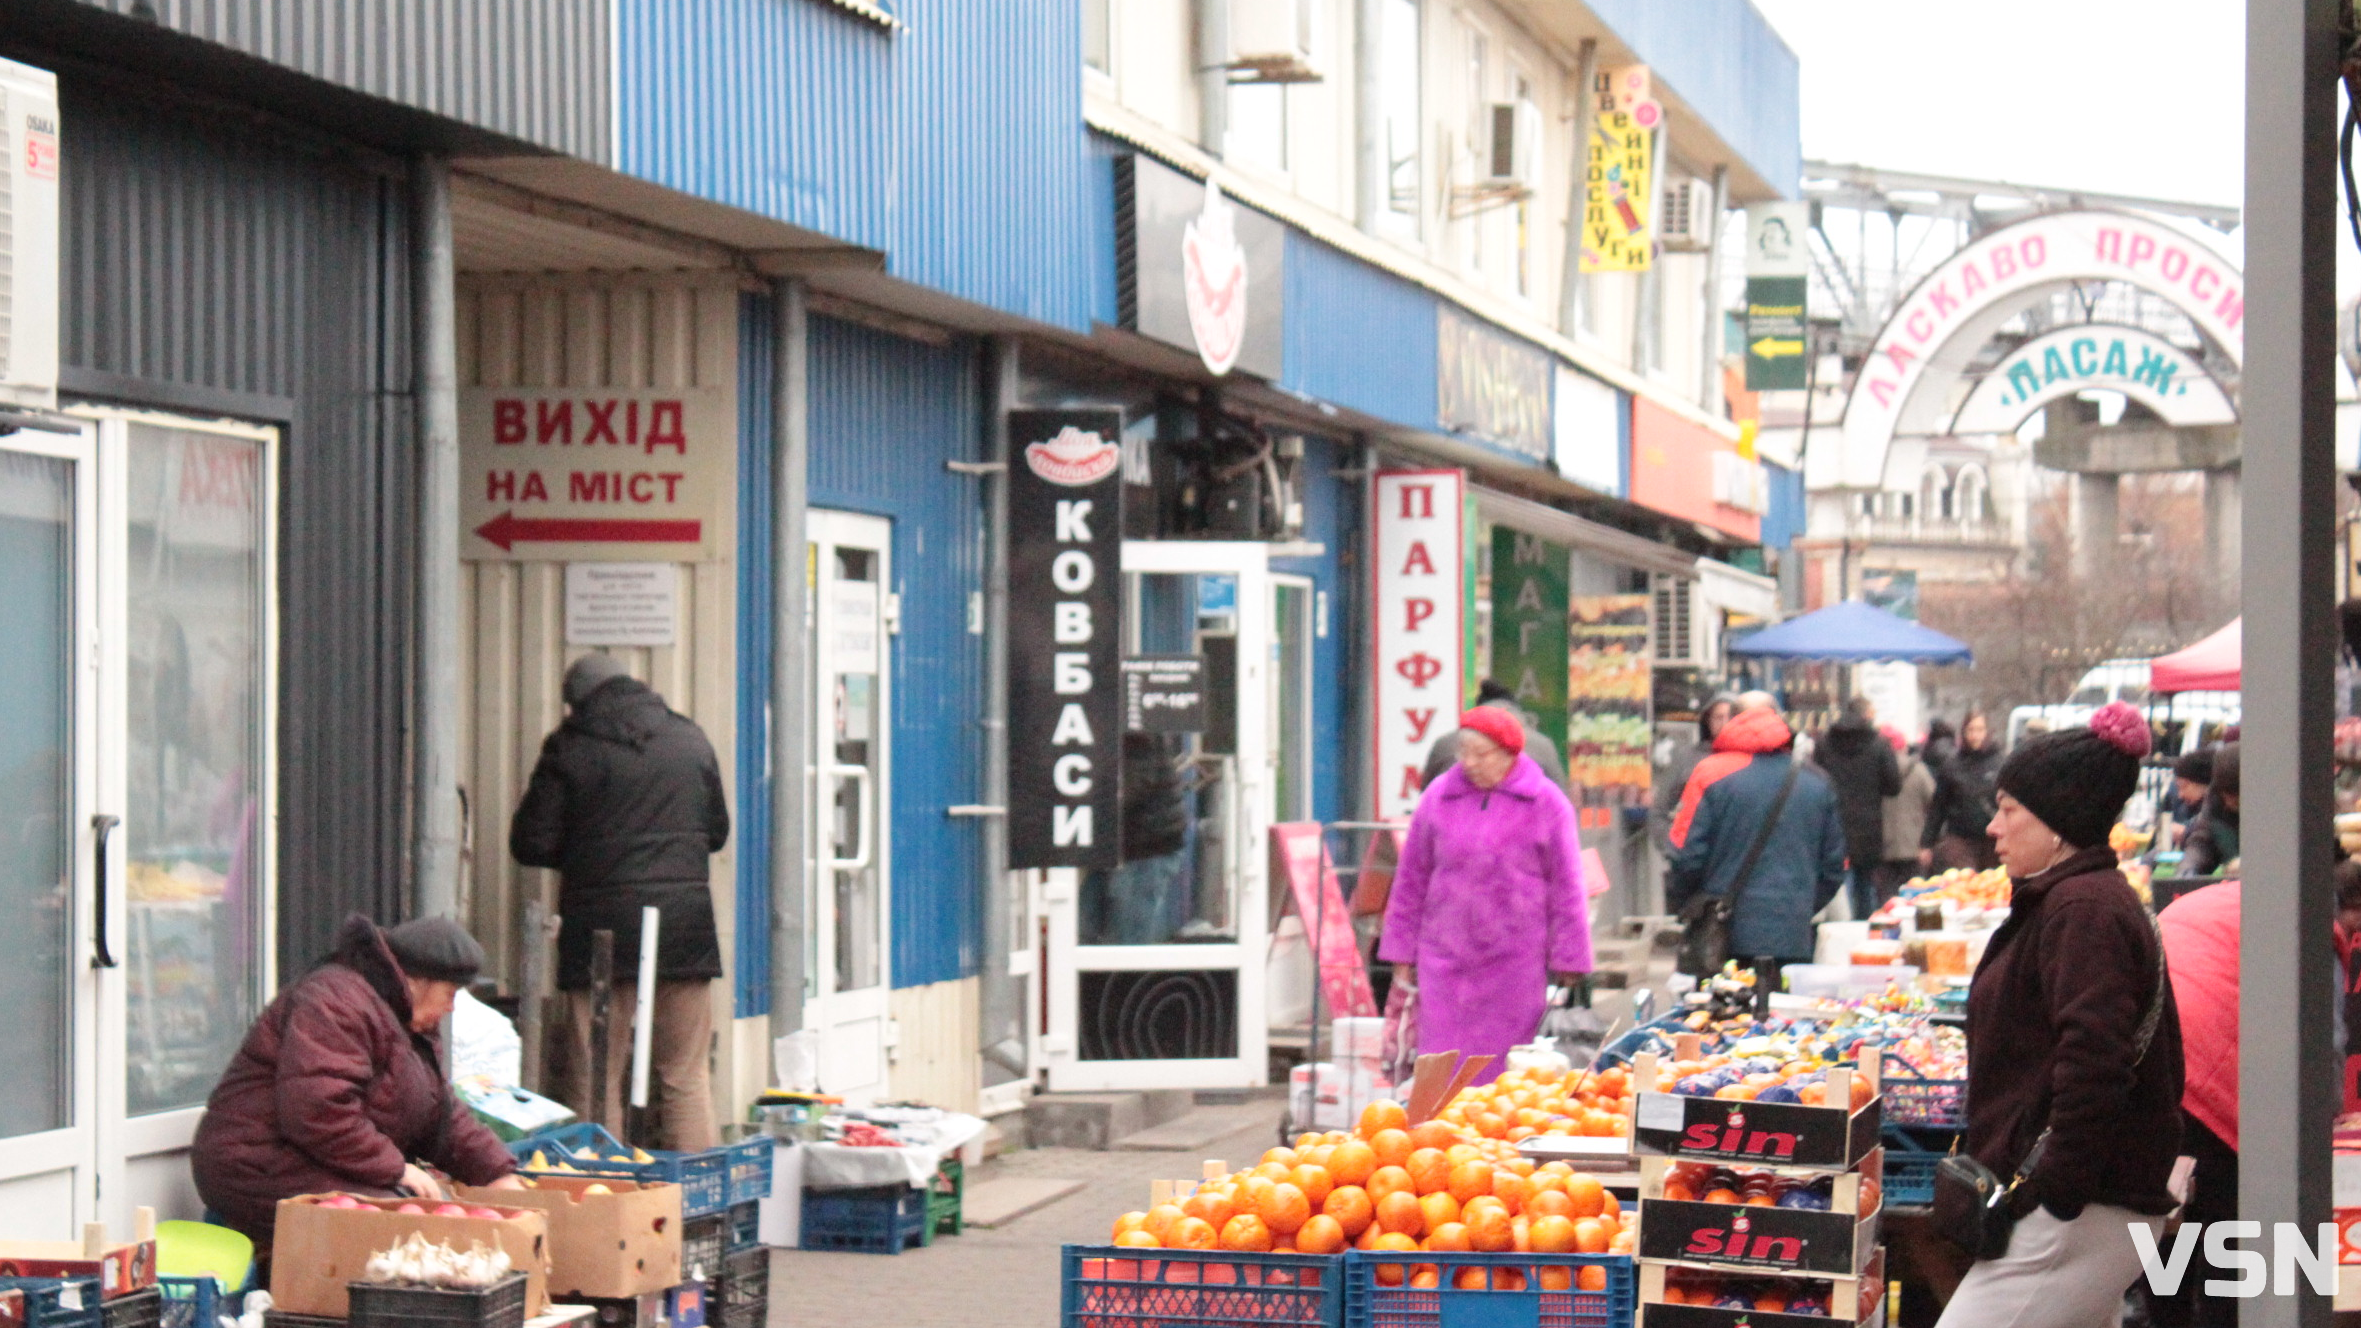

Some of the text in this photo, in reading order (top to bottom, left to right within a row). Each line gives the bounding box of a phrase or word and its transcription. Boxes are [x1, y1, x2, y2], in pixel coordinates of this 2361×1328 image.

[27, 140, 39, 168] 5
[1867, 227, 2244, 410] ЛАСКАВО ПРОСИ
[493, 399, 687, 455] ВИХІД
[486, 470, 684, 503] НА МІСТ
[1051, 499, 1095, 847] КОВБАСИ
[1680, 1113, 1797, 1156] sin
[1685, 1216, 1803, 1261] sin
